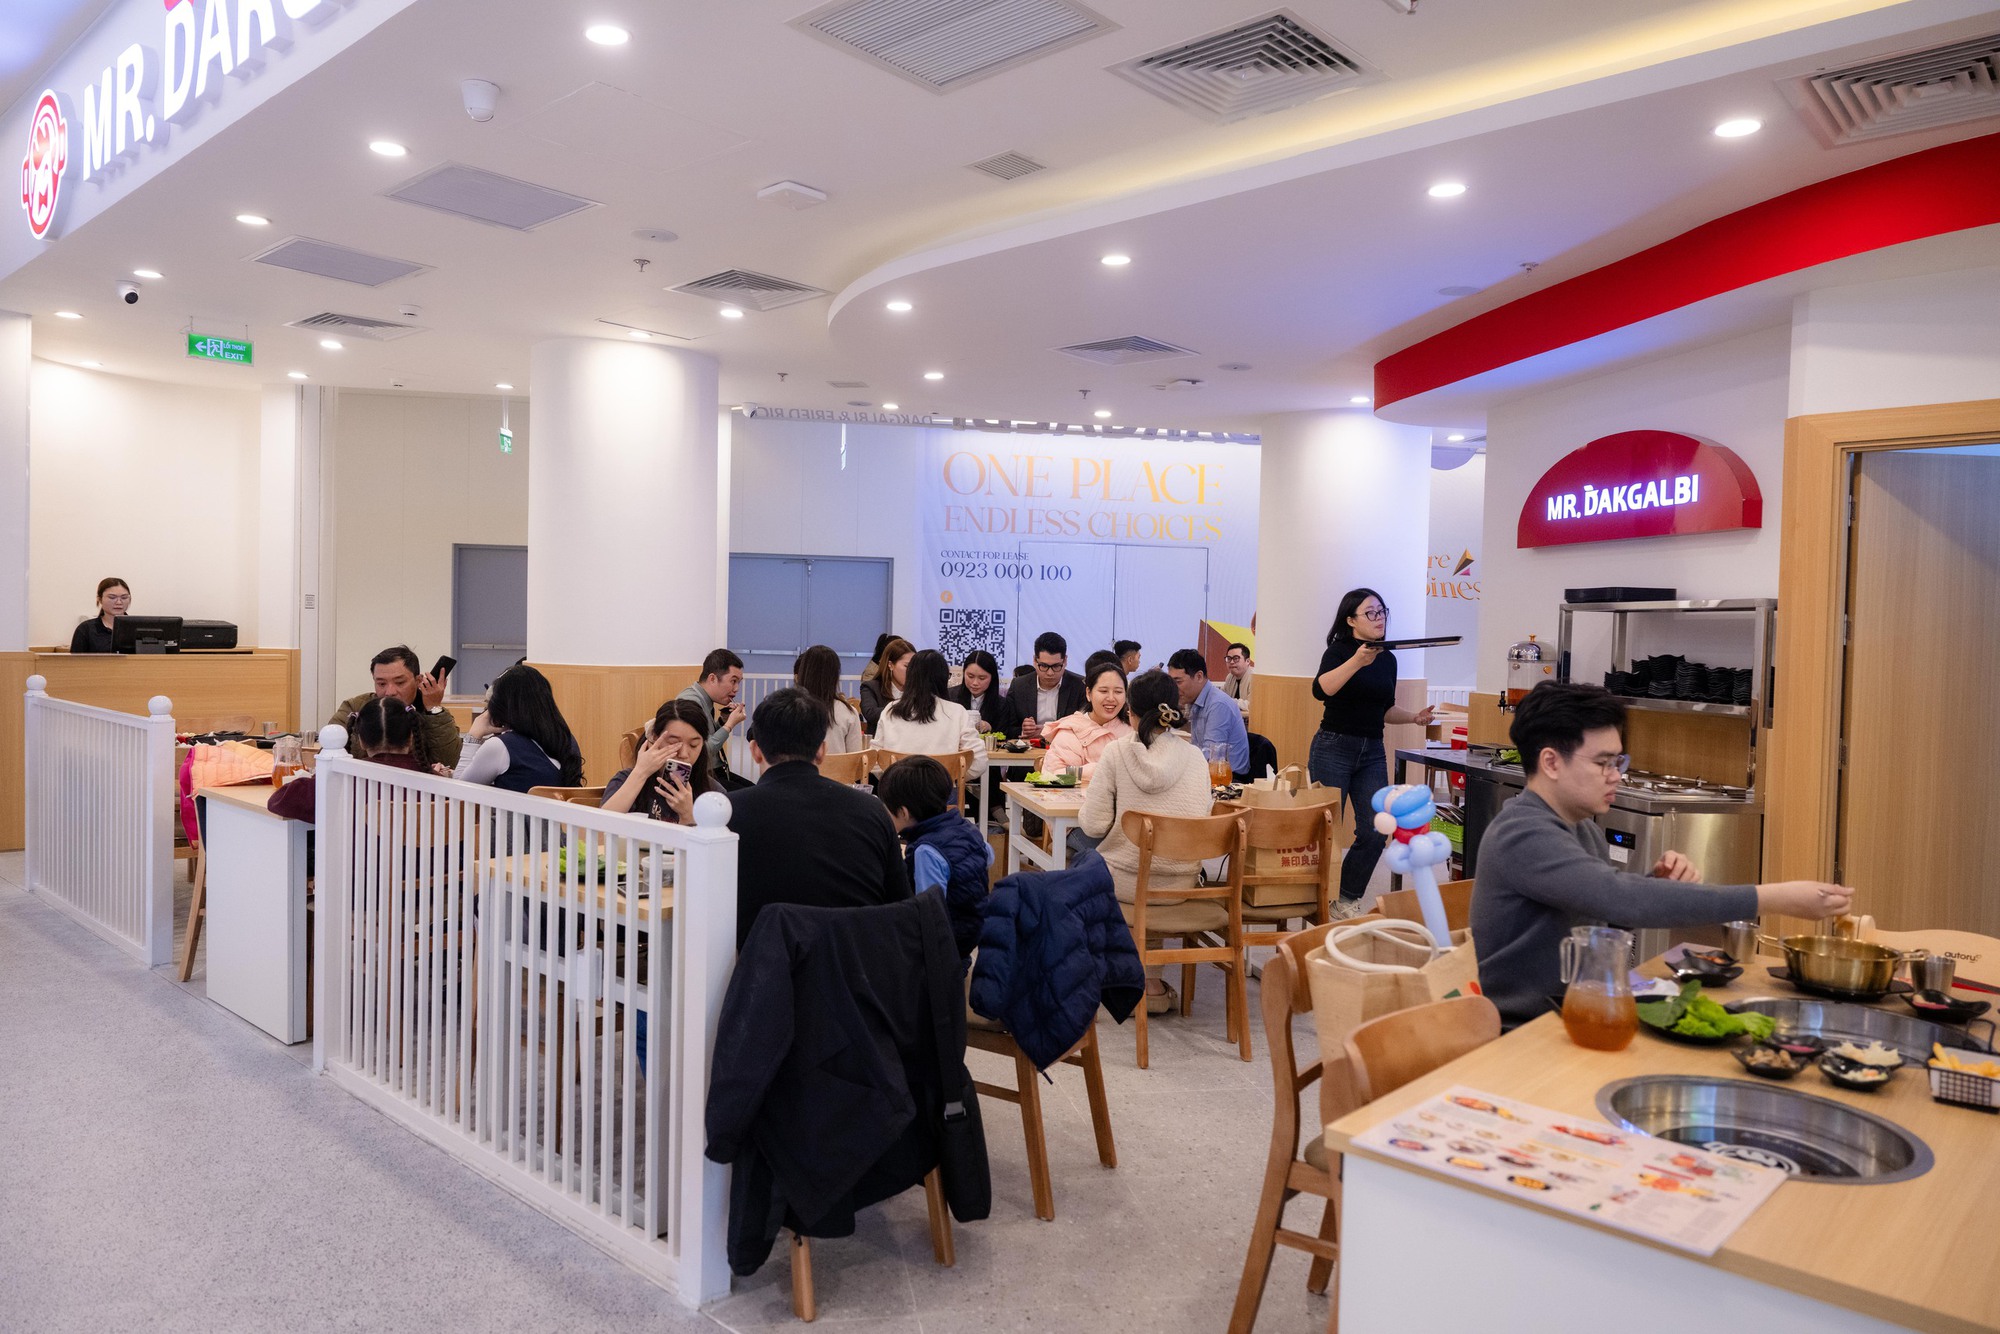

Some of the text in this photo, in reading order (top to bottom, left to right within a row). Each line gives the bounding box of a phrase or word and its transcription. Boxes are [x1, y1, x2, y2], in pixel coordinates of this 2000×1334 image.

[83, 43, 155, 181] MR.
[225, 352, 244, 360] EXIT
[943, 451, 1224, 507] ONE PLACE
[1547, 474, 1699, 521] MR. DAKGALBI
[943, 505, 1223, 542] ENDLESS CHOICES
[940, 549, 1030, 561] CONTACT FOR LEASE
[941, 561, 1072, 581] 0923 000 100
